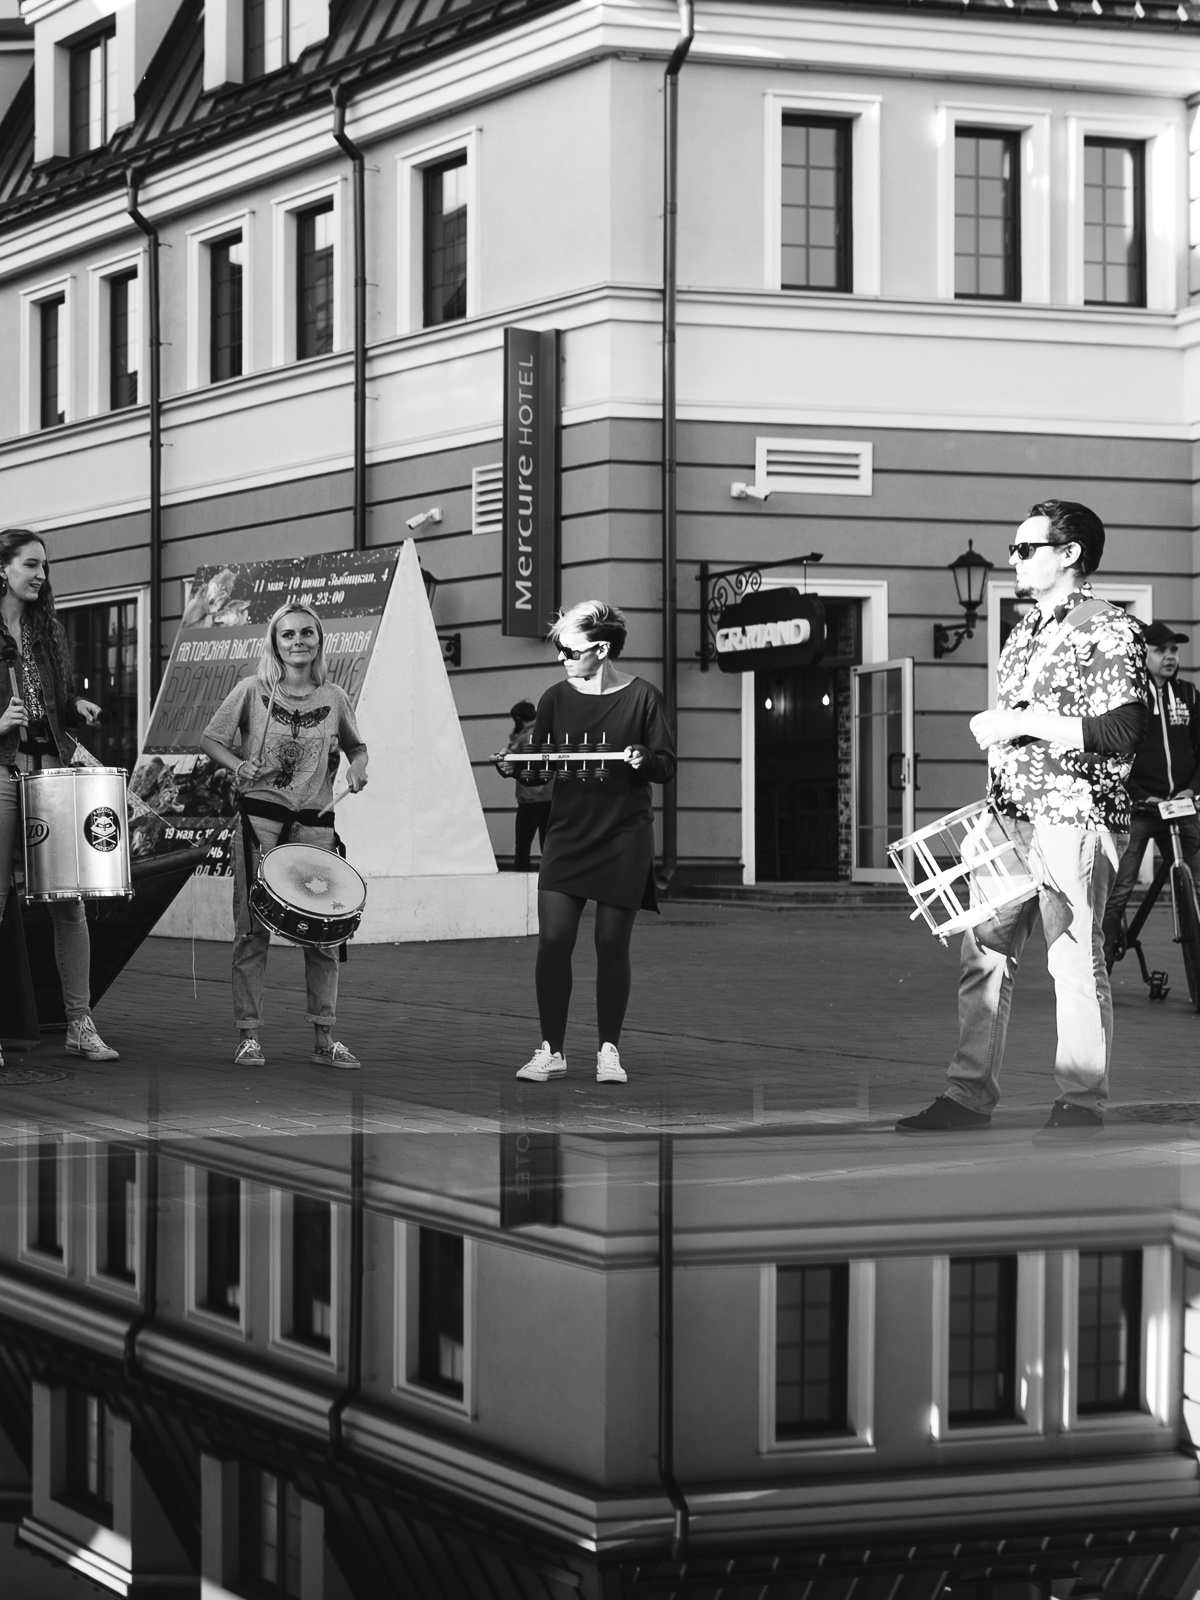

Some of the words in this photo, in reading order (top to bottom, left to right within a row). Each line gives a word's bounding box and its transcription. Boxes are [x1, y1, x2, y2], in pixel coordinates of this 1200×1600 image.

[518, 354, 534, 445] HOTEL
[515, 455, 533, 610] Mercure
[254, 579, 265, 592] 11
[301, 576, 326, 589] июня
[381, 568, 389, 581] 4
[286, 590, 345, 606] 11:00-23:00
[176, 639, 231, 663] АВТОРСКАЯ
[230, 637, 266, 660] ВЫСТА
[324, 630, 373, 655] ЛАЗКОВА
[164, 828, 175, 839] 19
[176, 830, 194, 839] мая
